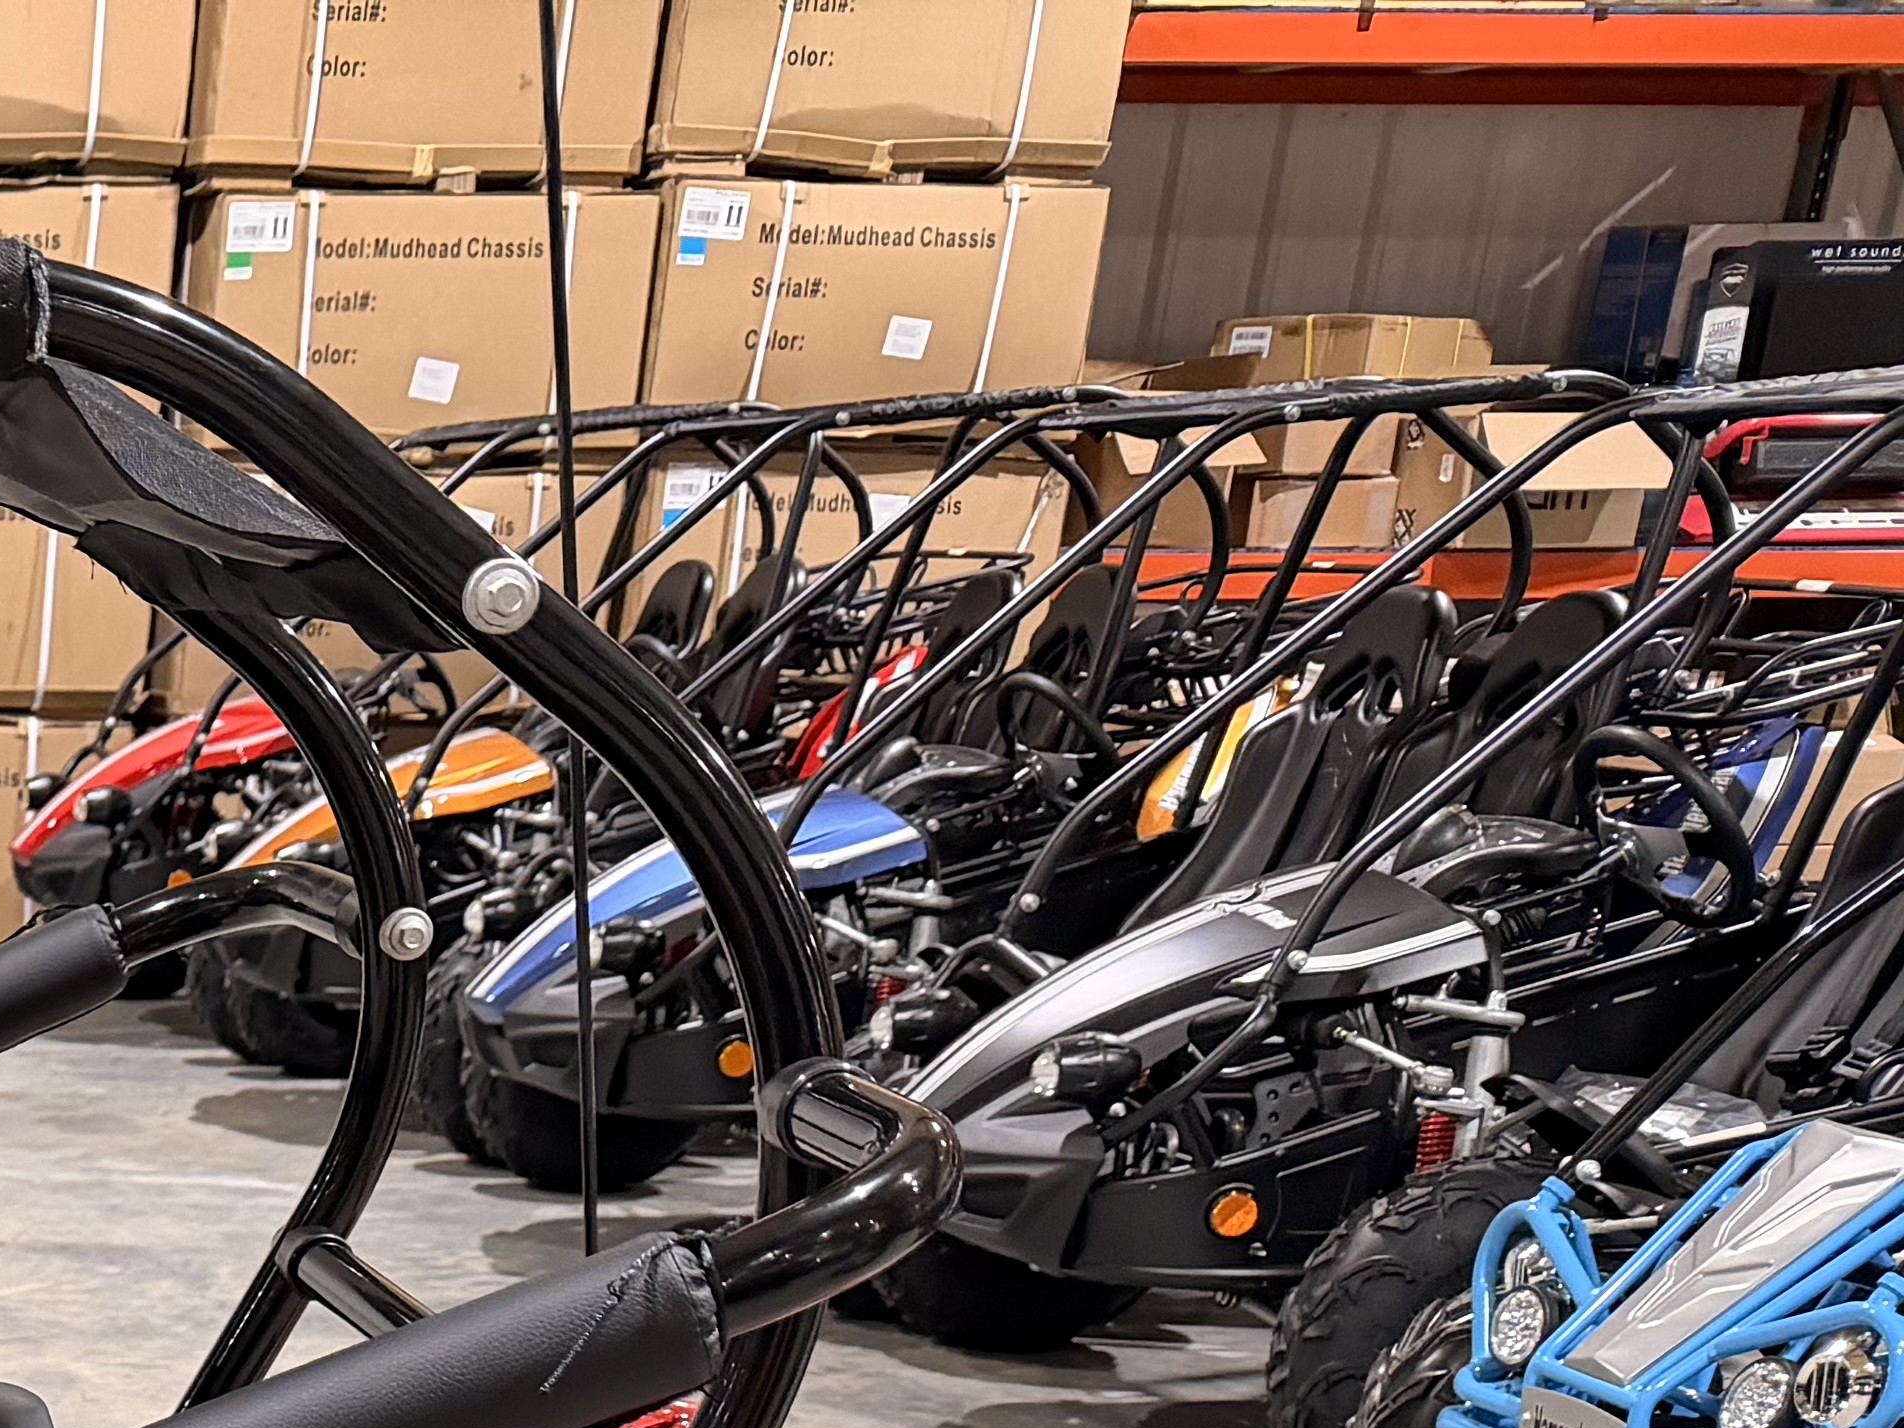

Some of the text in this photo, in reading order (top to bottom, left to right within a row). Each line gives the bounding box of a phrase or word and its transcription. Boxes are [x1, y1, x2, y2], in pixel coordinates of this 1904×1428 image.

[784, 45, 834, 67] olor:
[467, 237, 545, 259] Chassis
[920, 226, 996, 249] Chassis
[1850, 245, 1904, 258] sound
[312, 291, 377, 313] erial#:
[307, 343, 358, 365] olor:
